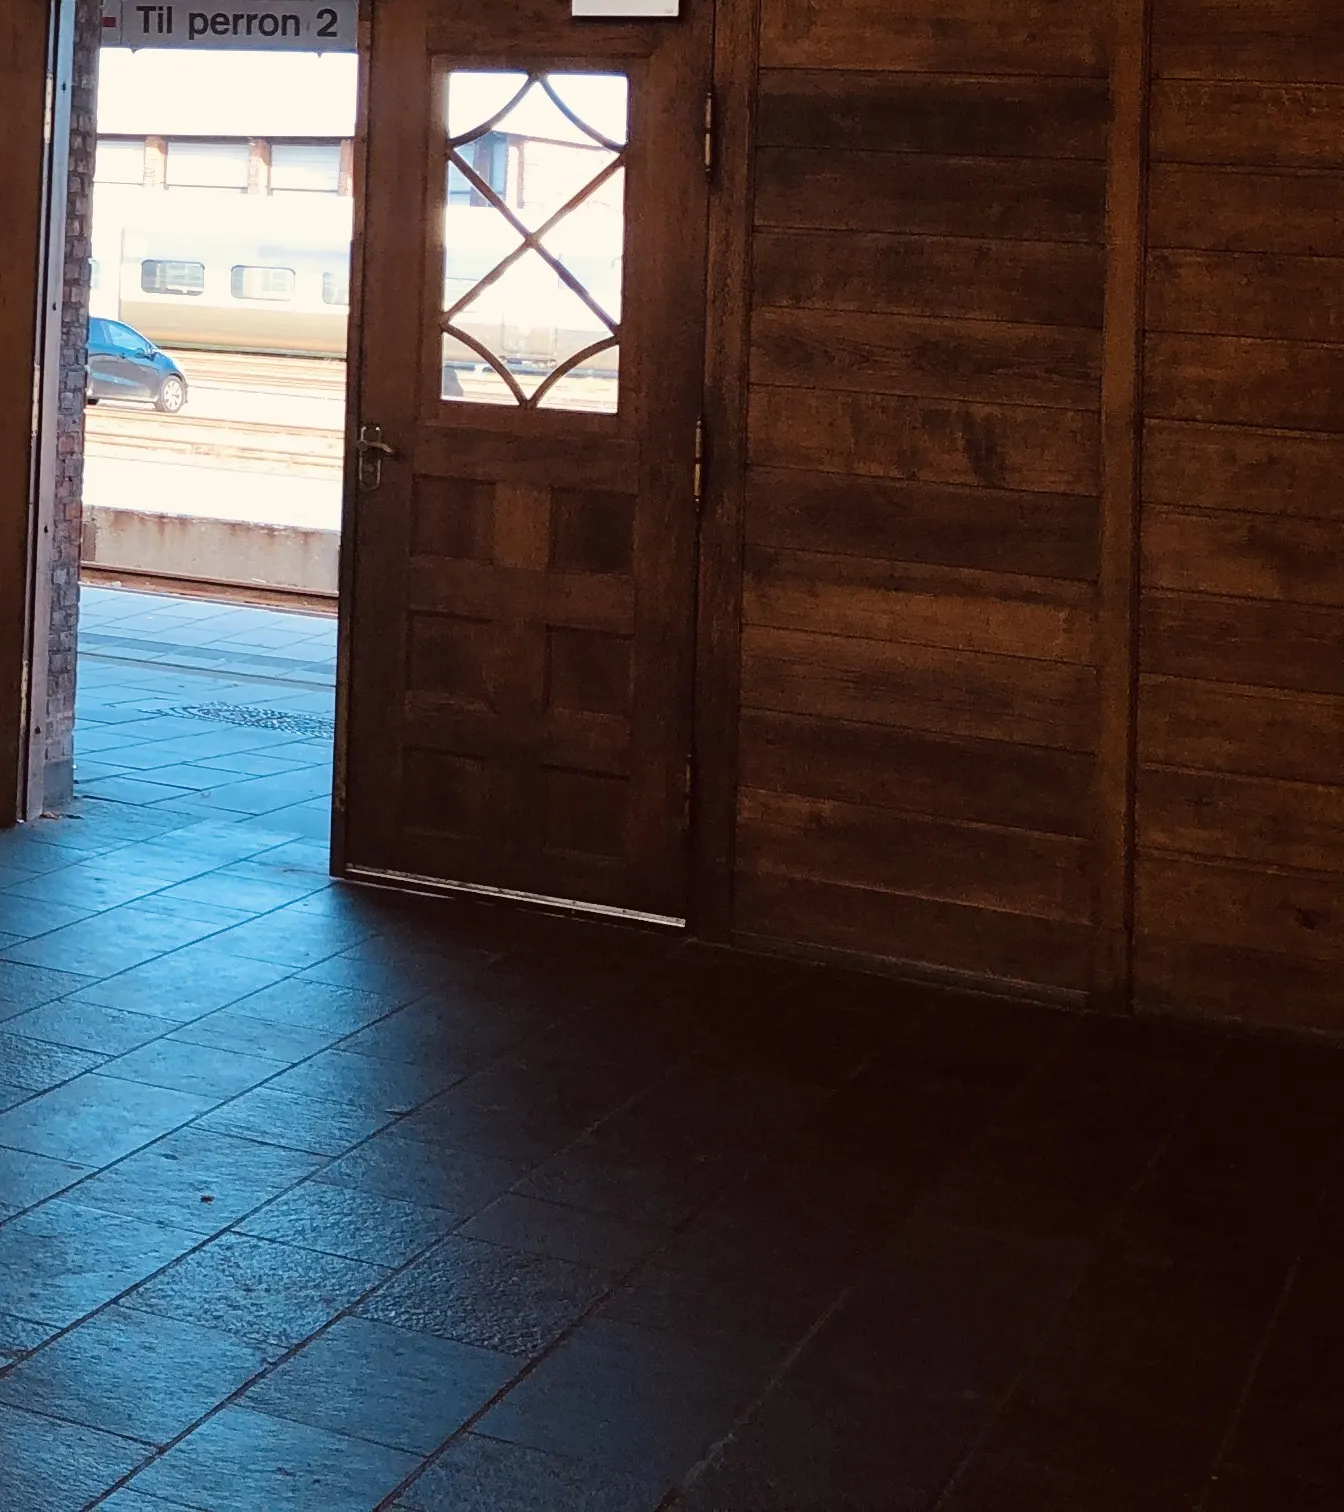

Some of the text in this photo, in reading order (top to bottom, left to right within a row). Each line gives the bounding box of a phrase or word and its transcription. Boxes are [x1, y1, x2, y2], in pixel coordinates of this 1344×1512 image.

[136, 6, 338, 40] Til perron 2
